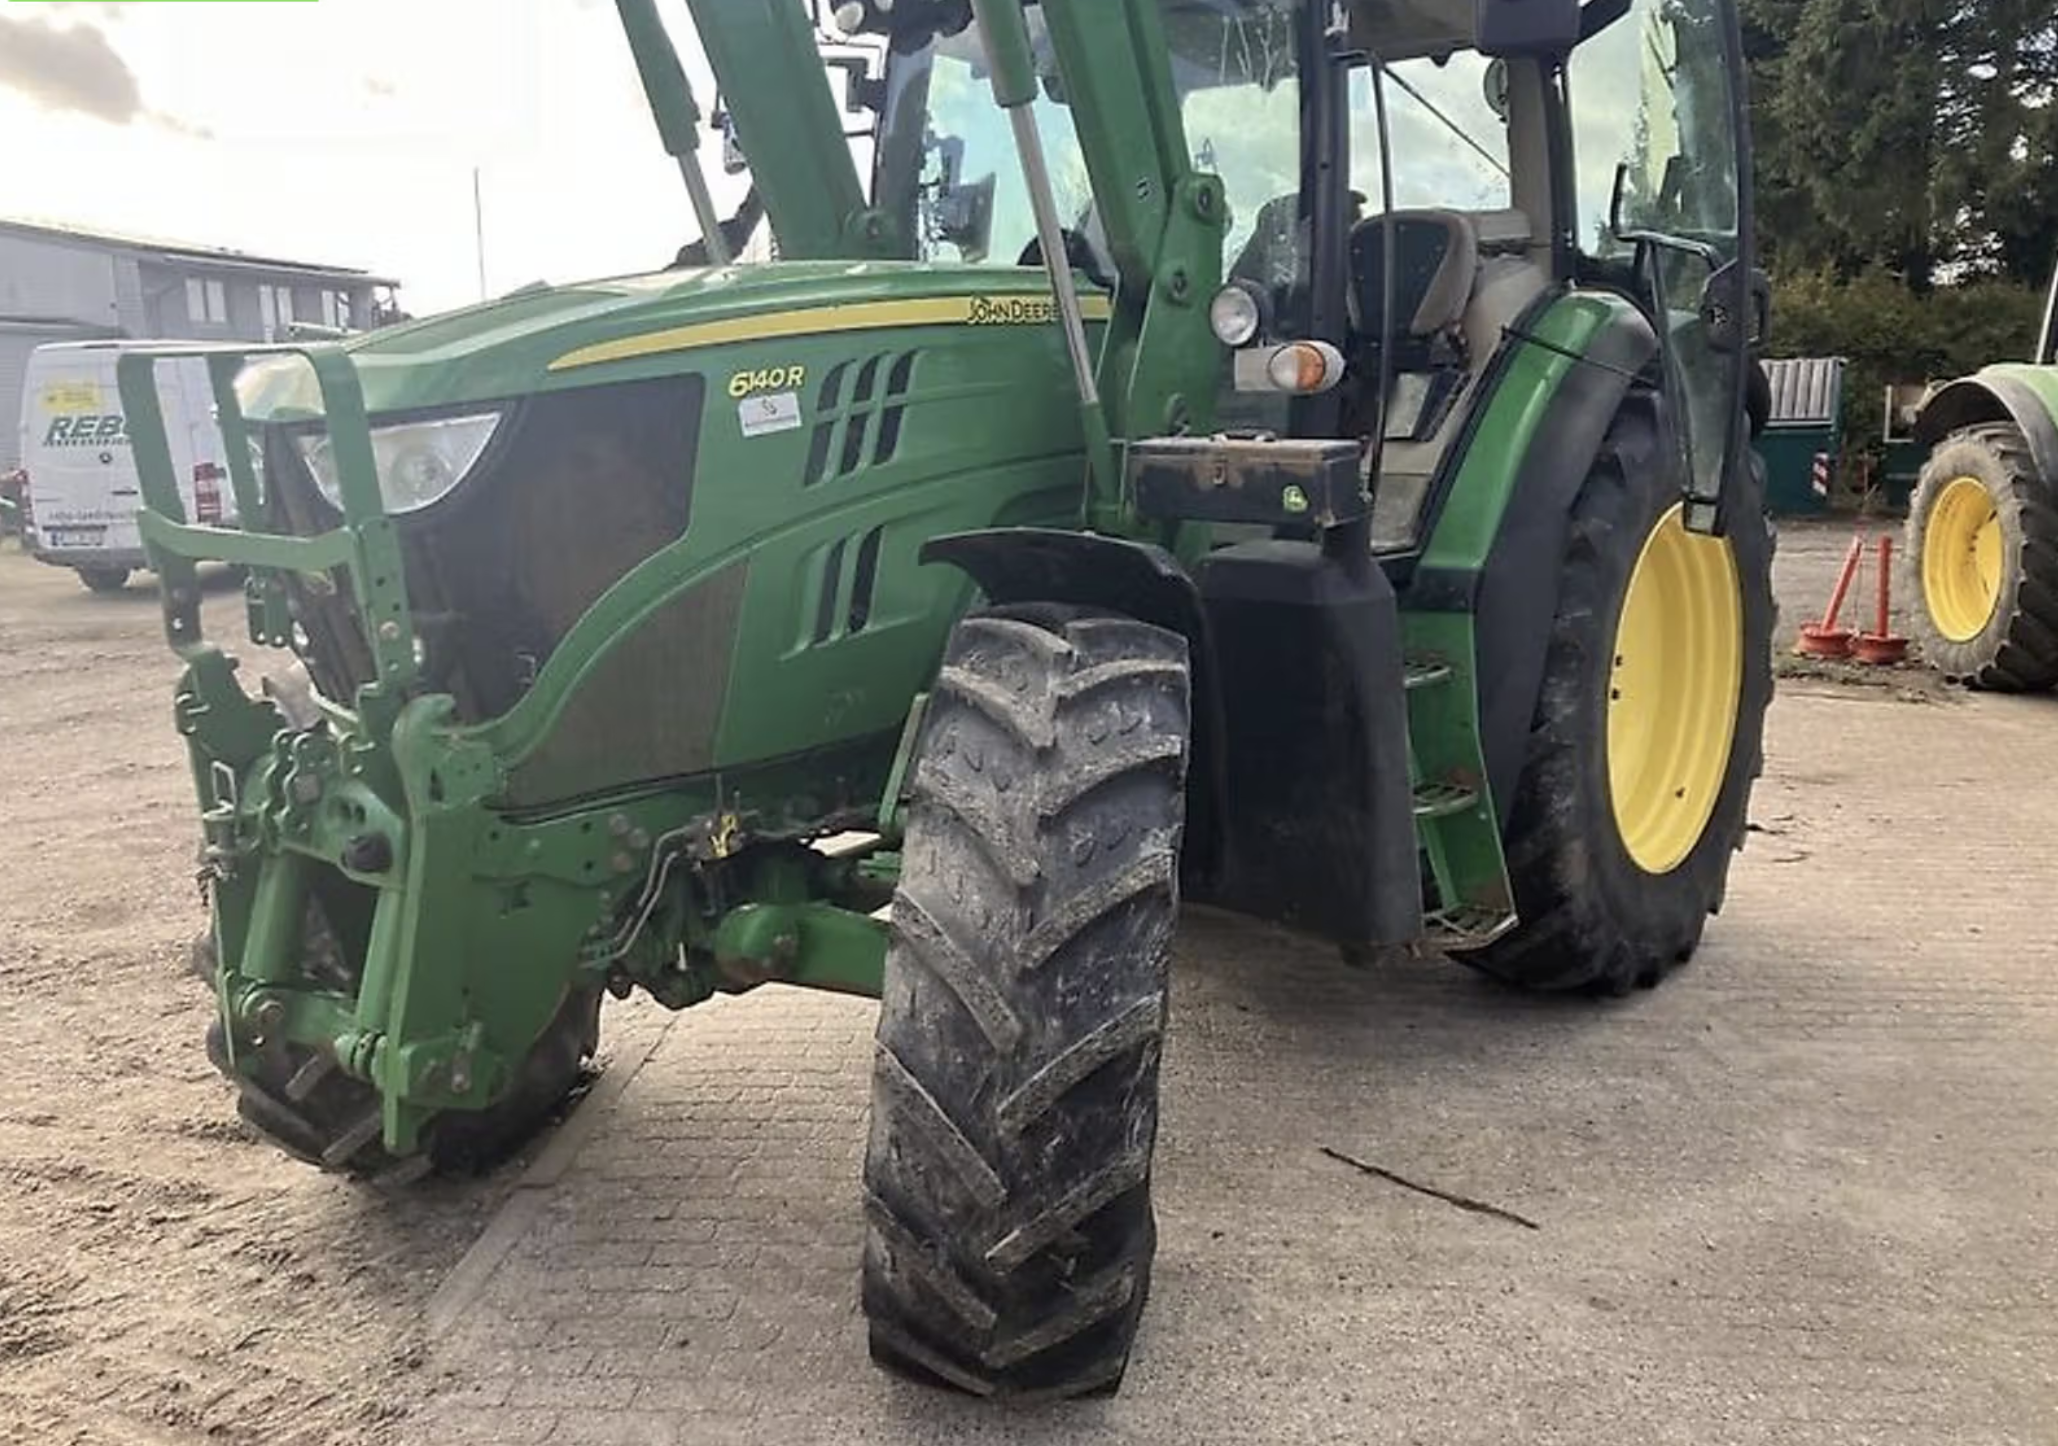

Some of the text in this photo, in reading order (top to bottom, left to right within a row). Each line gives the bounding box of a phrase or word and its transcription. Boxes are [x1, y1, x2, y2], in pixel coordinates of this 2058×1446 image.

[967, 297, 1063, 321] JOHN DEERE
[46, 415, 128, 442] REB
